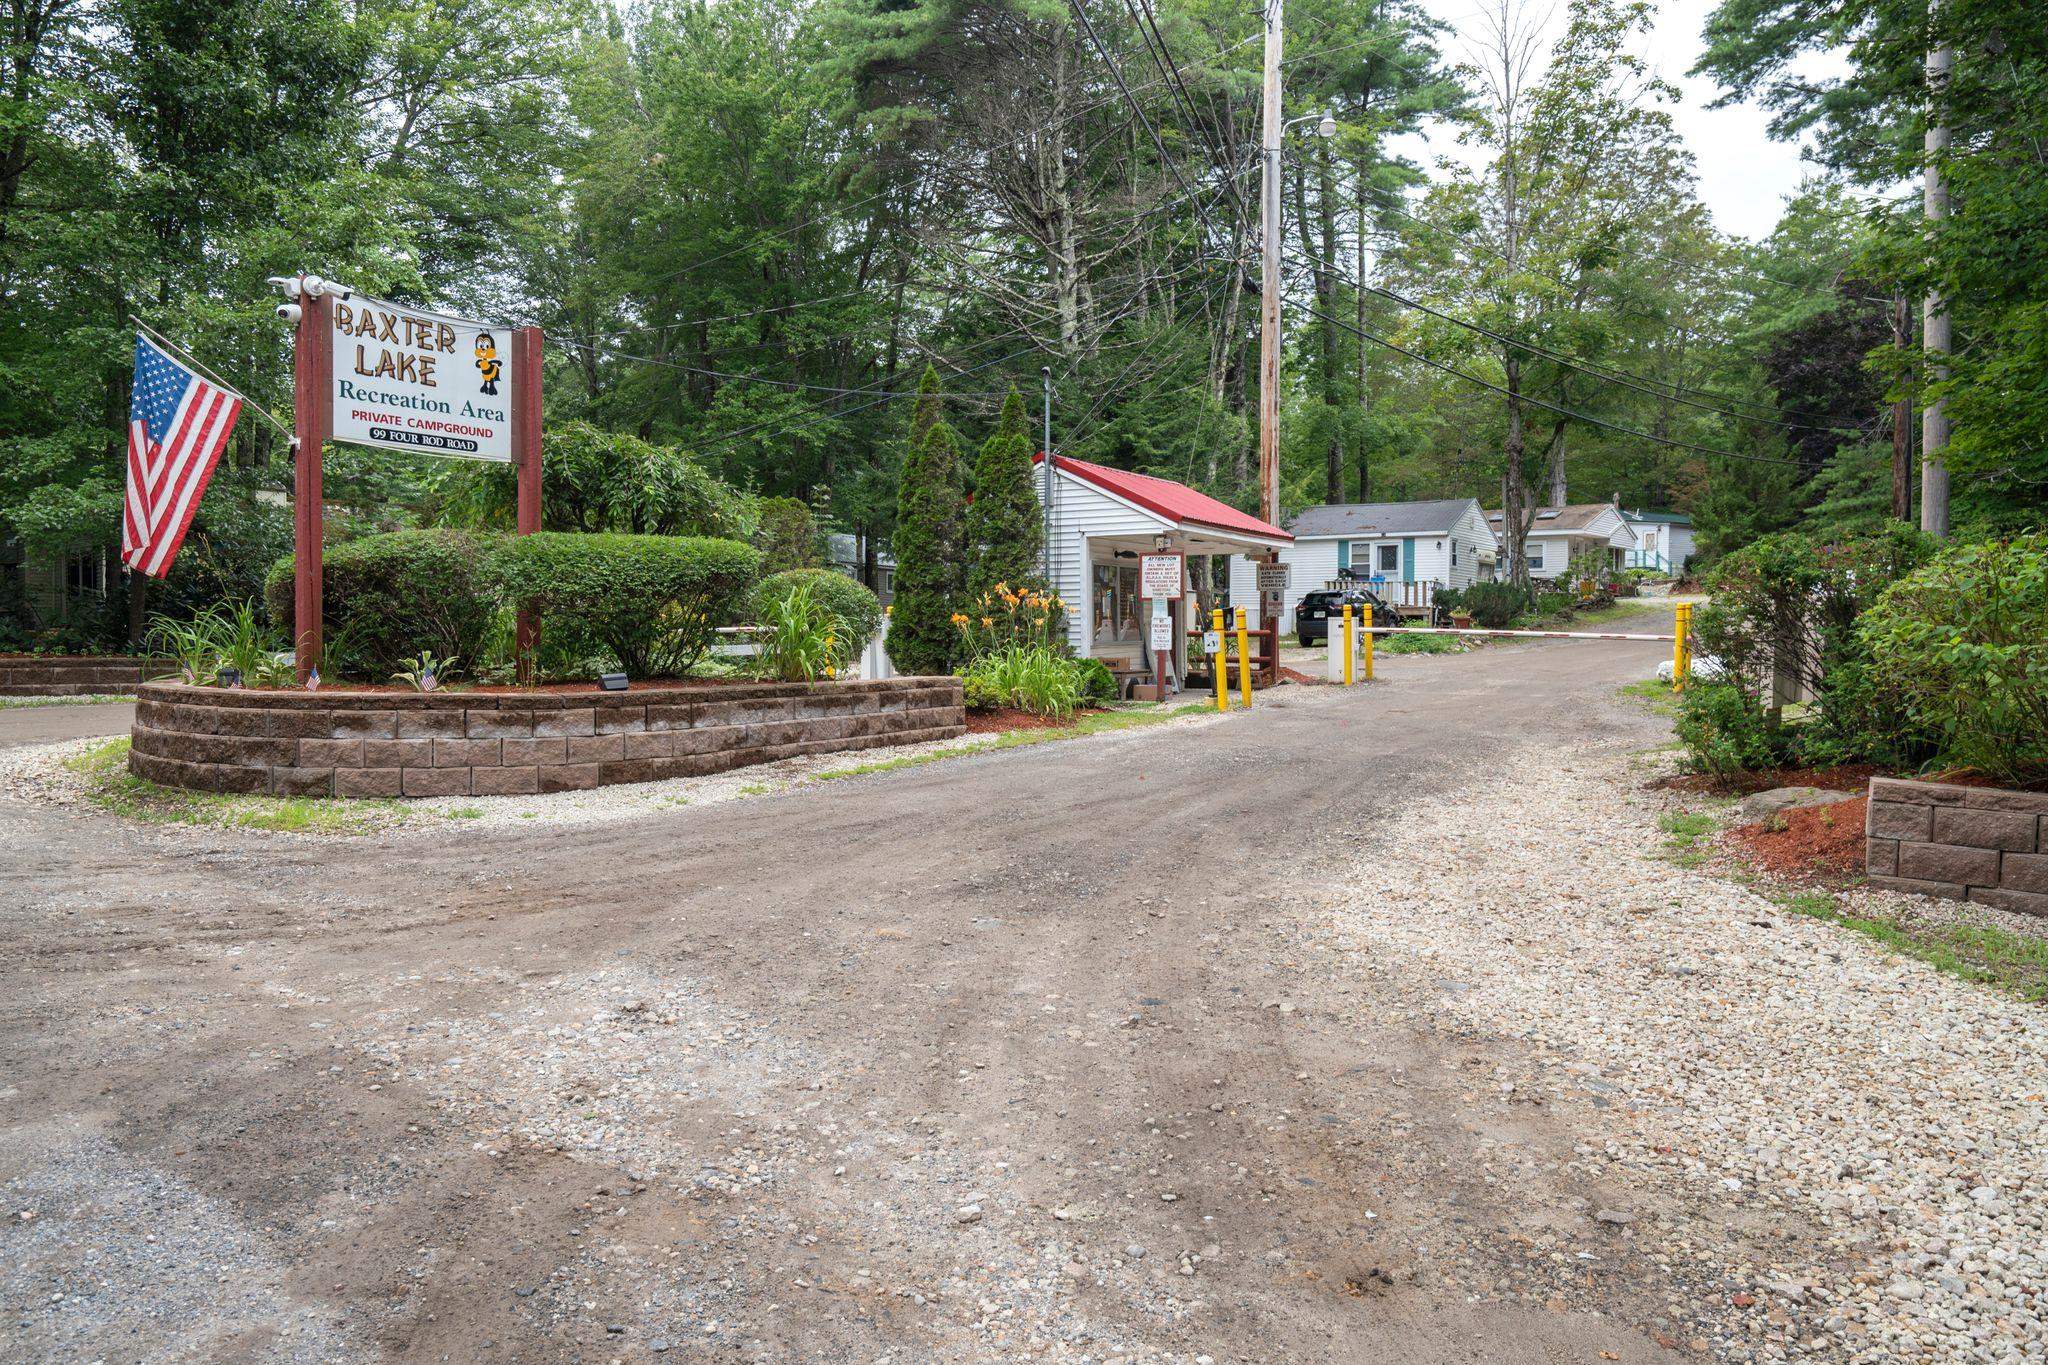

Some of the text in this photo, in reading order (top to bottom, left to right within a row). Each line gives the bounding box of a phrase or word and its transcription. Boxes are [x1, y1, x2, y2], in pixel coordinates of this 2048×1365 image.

[333, 303, 456, 354] BAXTER
[354, 344, 437, 388] LAKE
[338, 379, 505, 422] Recreation Area
[351, 409, 493, 438] PRIVATE CAMPGROUND
[372, 429, 475, 451] 99 FOUR ROD ROAD
